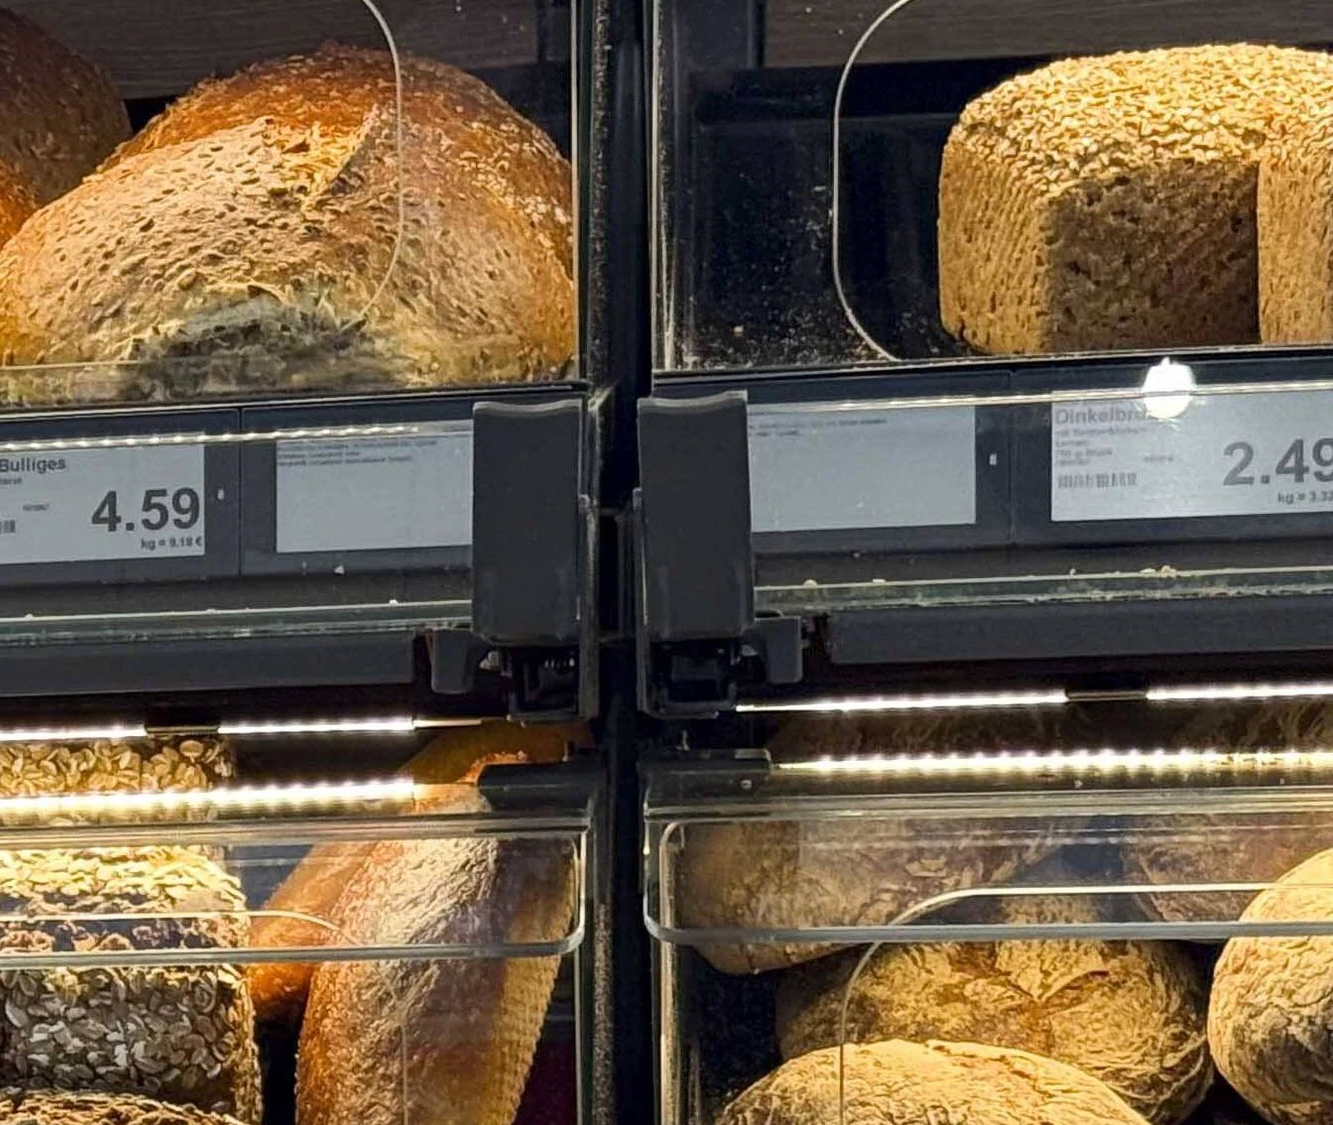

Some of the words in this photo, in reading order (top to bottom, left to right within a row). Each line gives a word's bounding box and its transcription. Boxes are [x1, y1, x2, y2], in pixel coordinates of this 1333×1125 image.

[1223, 437, 1333, 486] 2.49
[91, 487, 201, 532] 4.59
[140, 538, 156, 551] kg
